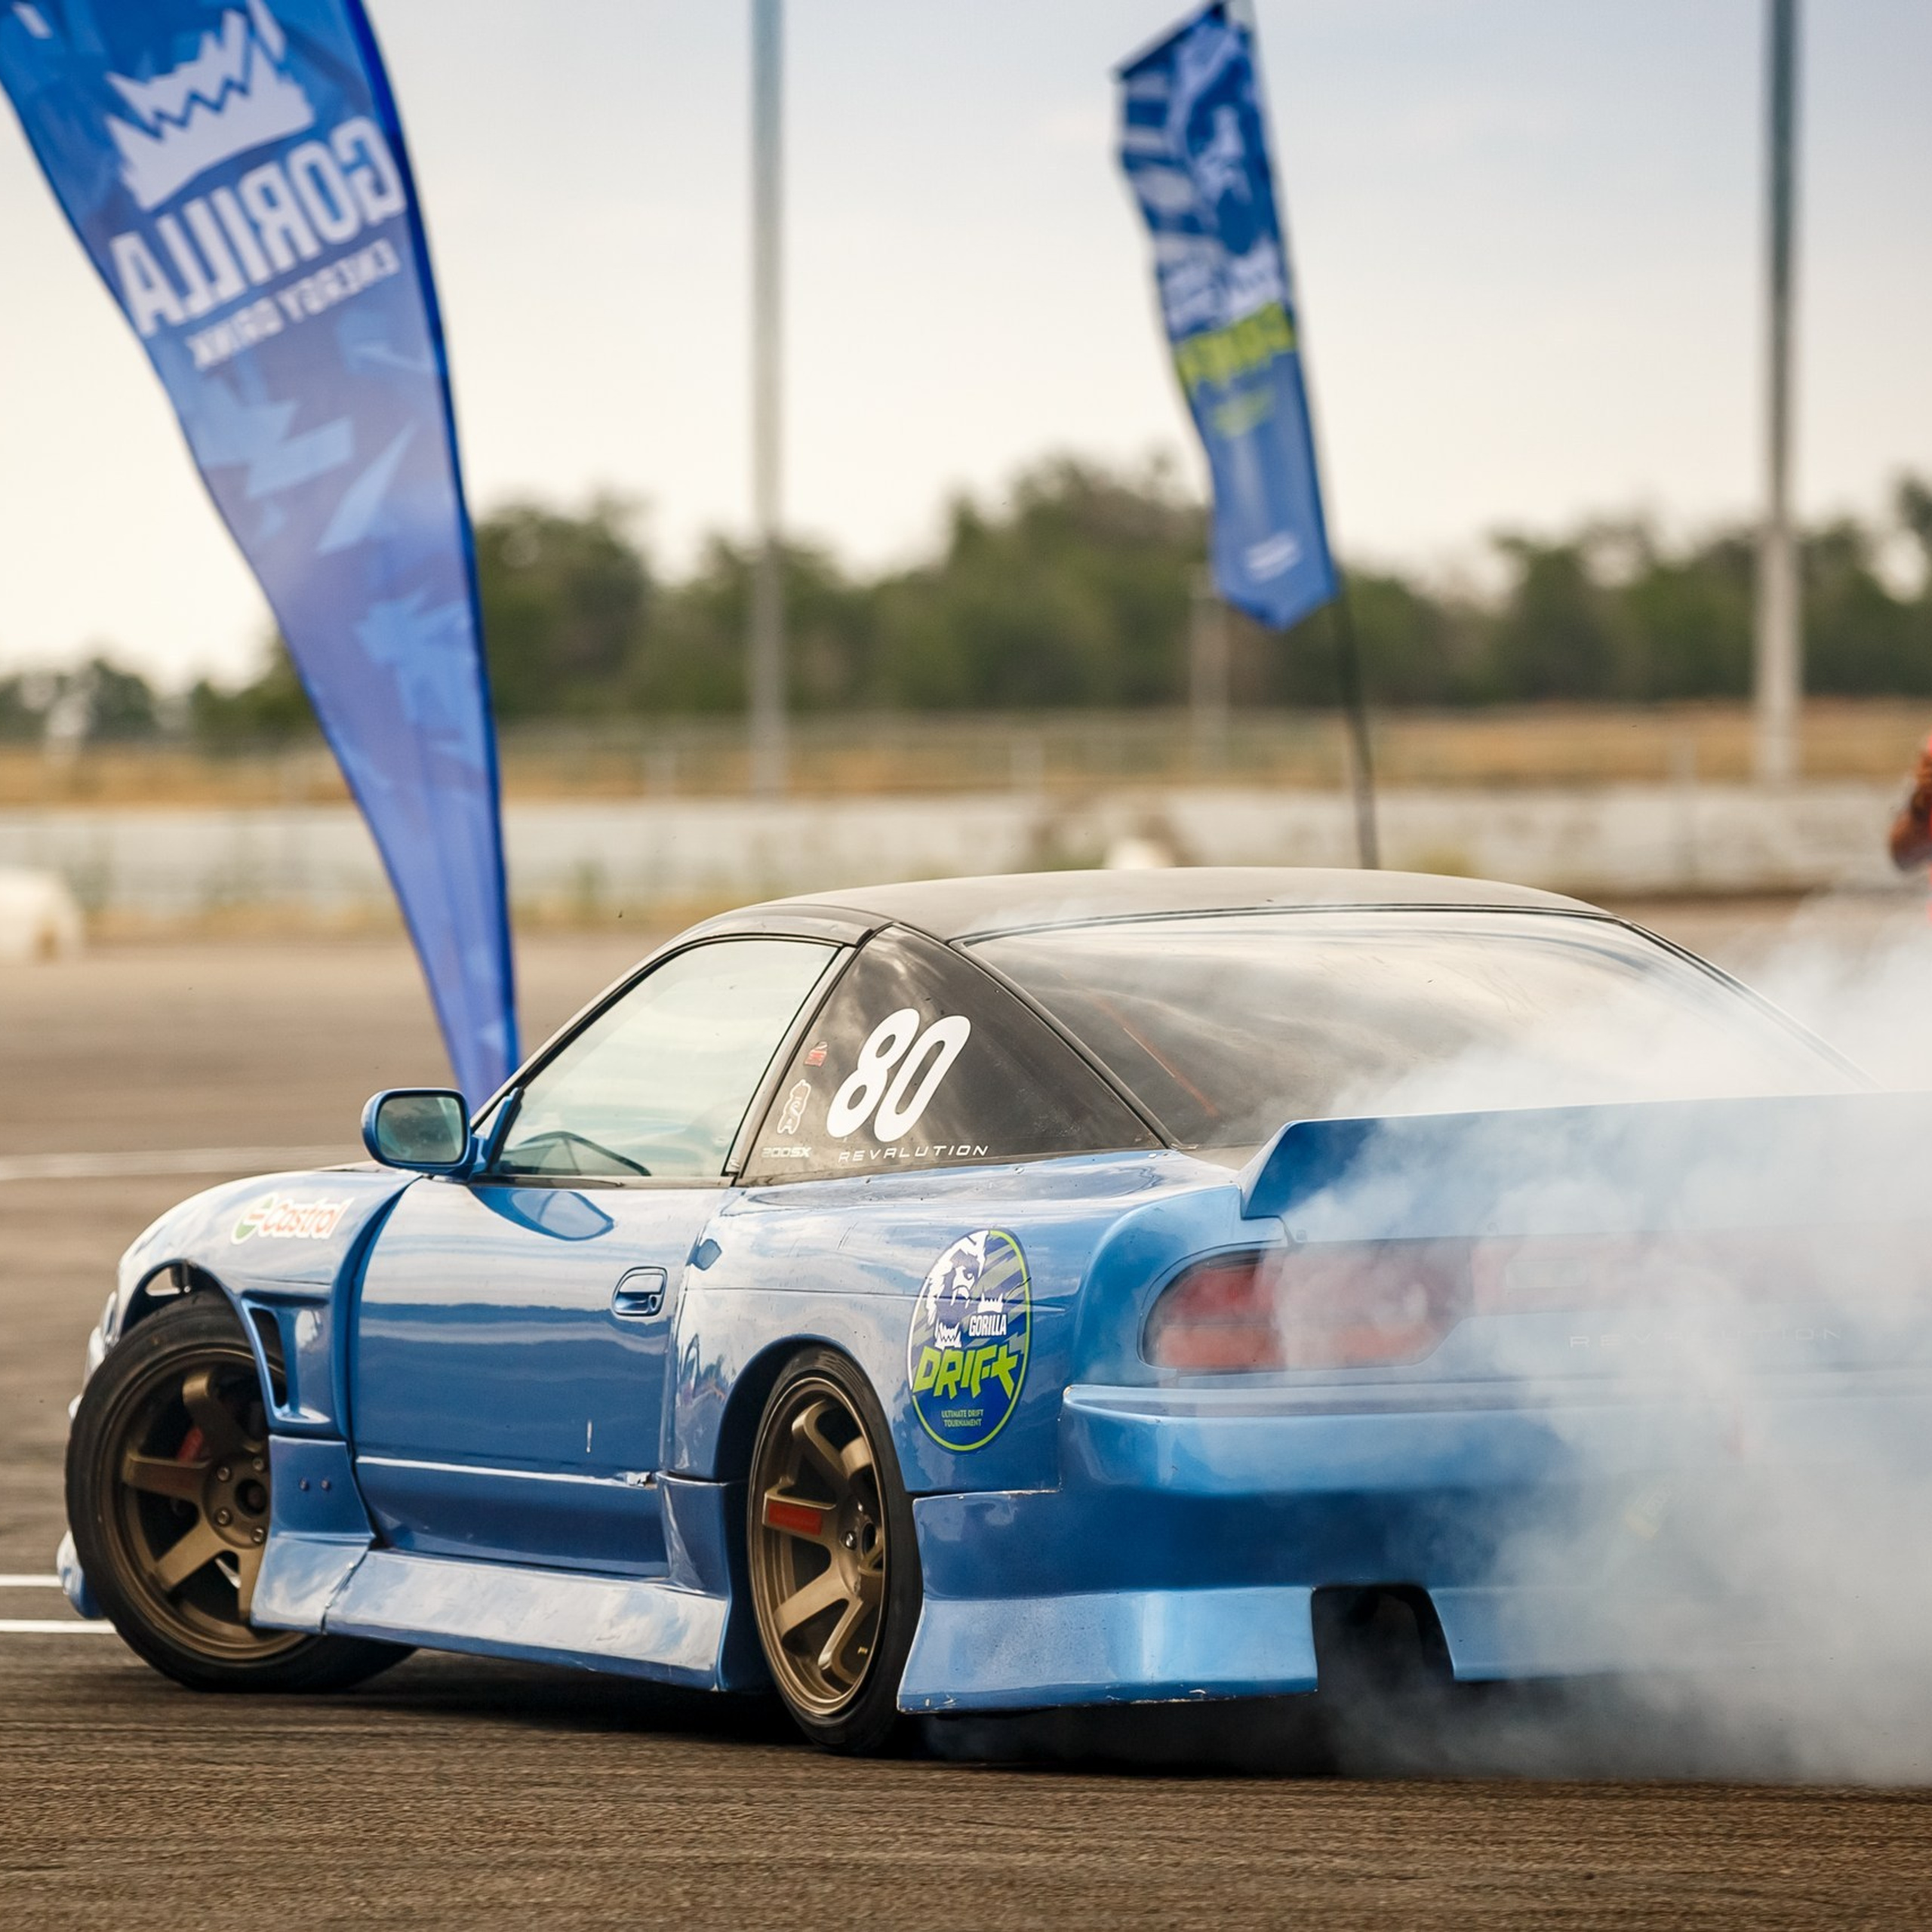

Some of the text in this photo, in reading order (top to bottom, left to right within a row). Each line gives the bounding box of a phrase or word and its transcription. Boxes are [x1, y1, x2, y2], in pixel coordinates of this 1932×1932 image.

[826, 1008, 971, 1142] 80
[838, 1145, 989, 1163] REVALUTION
[260, 1198, 353, 1236] Castrol
[968, 1314, 1007, 1336] GORILLA
[912, 1344, 1019, 1399] DRIFT
[941, 1408, 984, 1418] ULTIMATE DRIFT
[943, 1418, 983, 1427] TOURNAMENT
